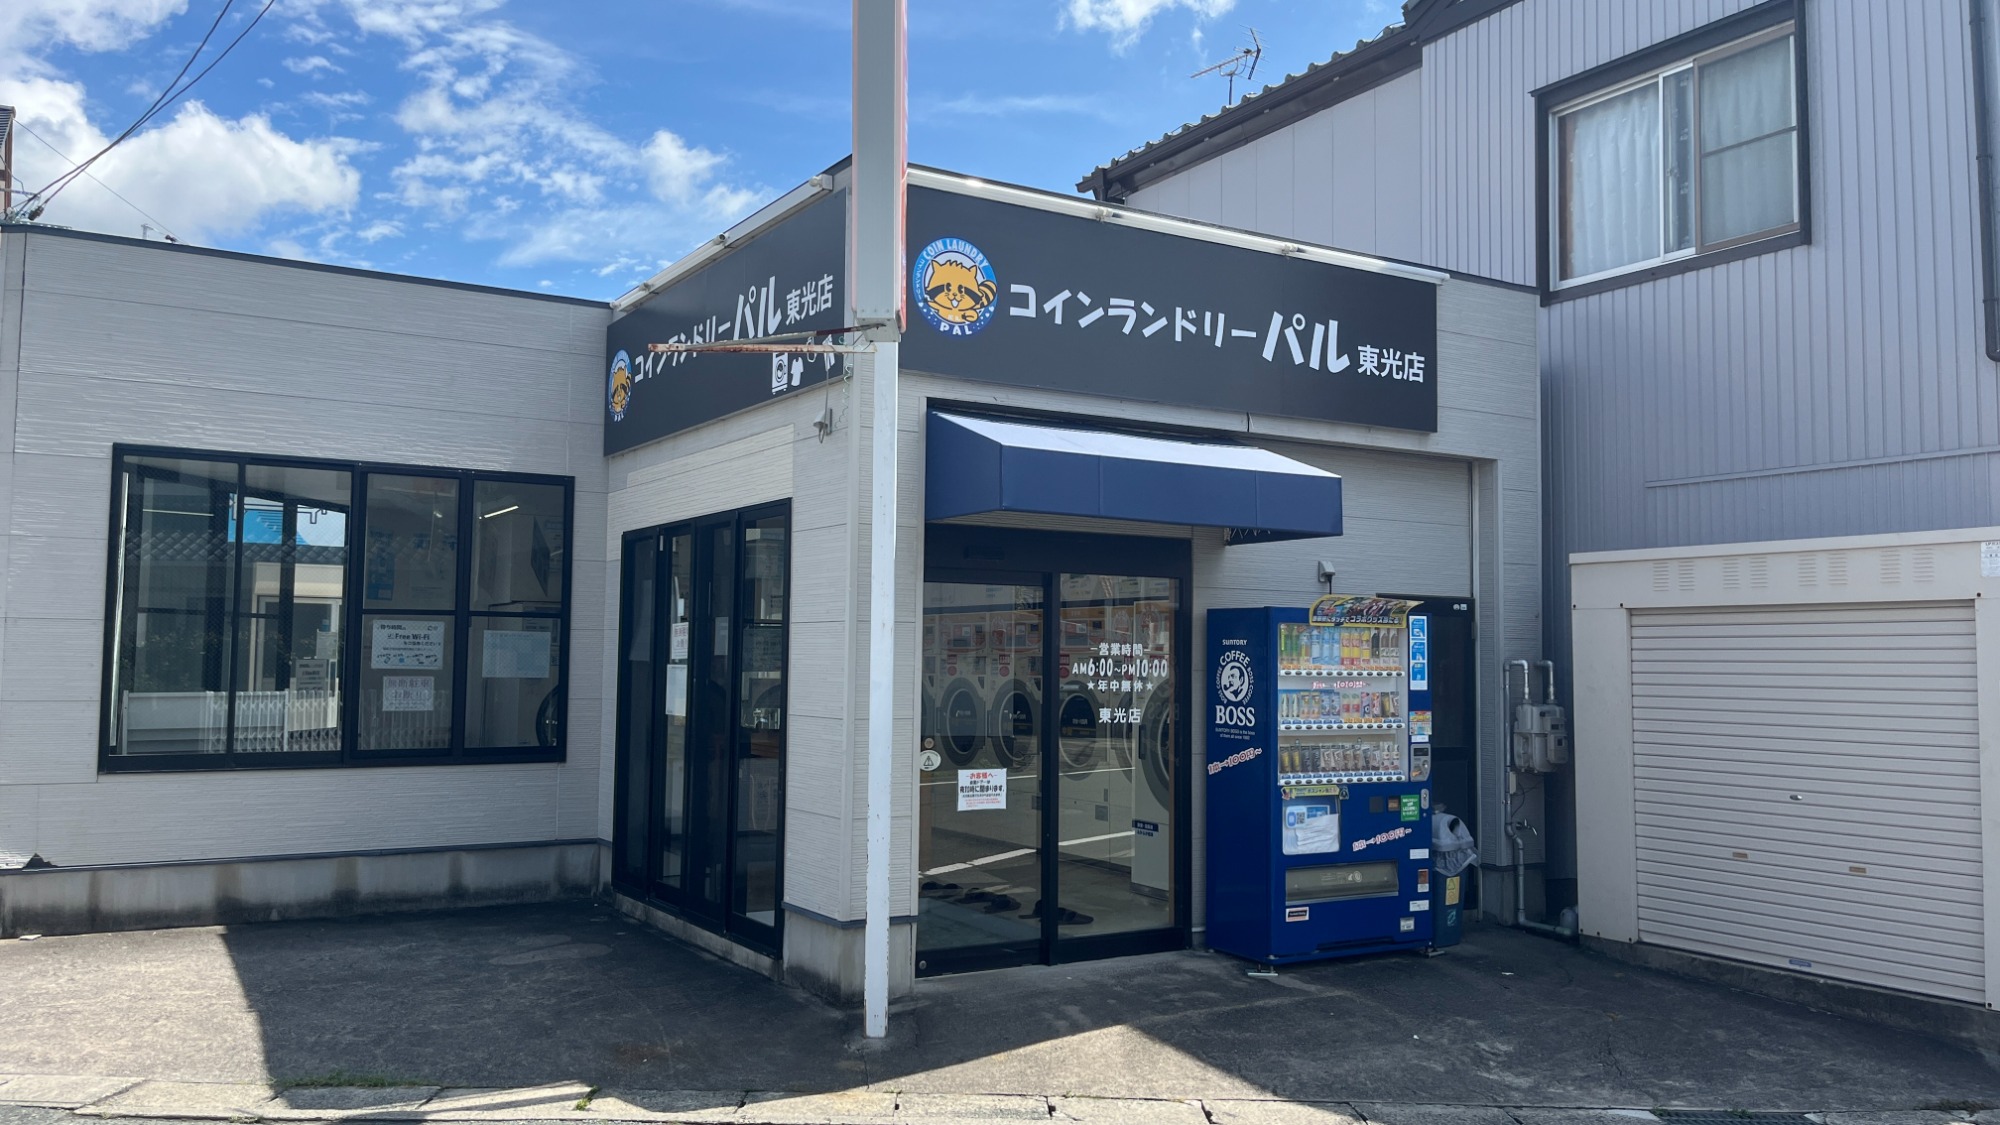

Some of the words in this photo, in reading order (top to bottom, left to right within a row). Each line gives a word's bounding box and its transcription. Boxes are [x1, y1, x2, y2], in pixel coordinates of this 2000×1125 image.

[922, 240, 945, 260] COIN
[946, 239, 990, 268] LAUNDRY
[786, 273, 833, 325] 東光店
[939, 321, 973, 336] PAL
[1357, 344, 1425, 383] 東光店
[1220, 650, 1251, 667] COFFEE
[1098, 707, 1141, 724] 東光店
[1215, 705, 1255, 727] BOSS
